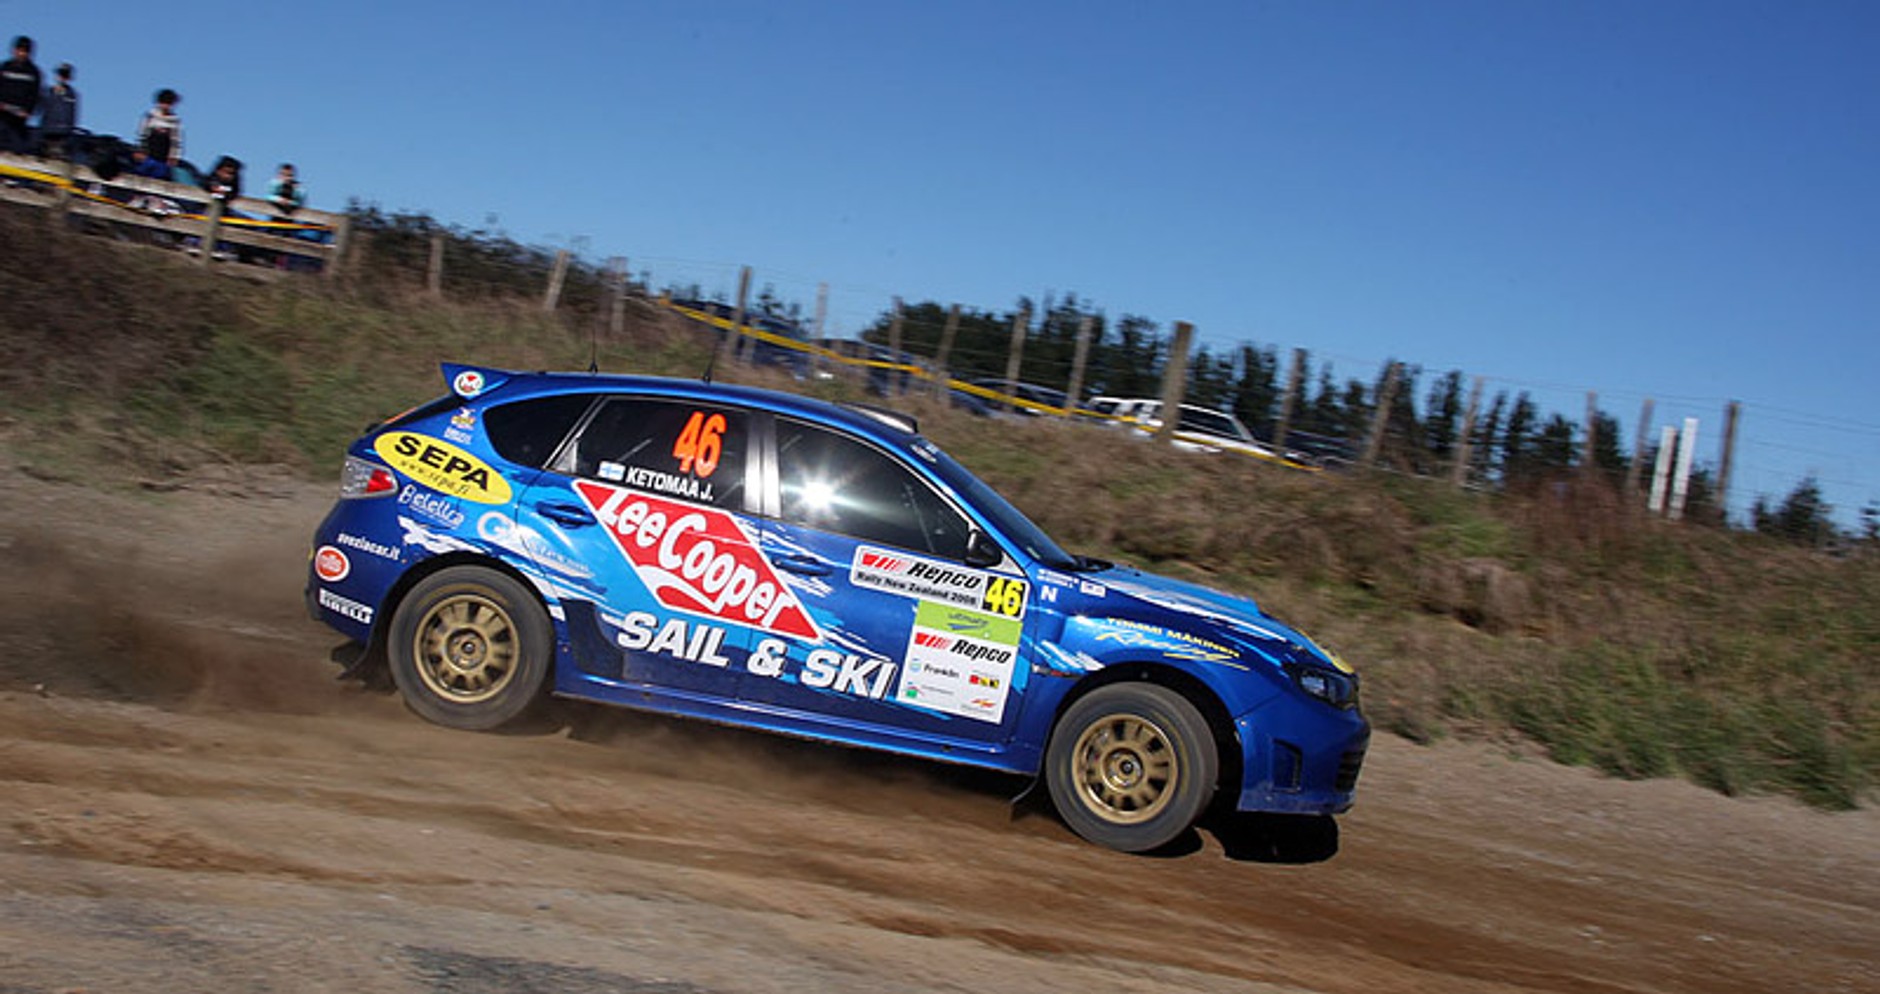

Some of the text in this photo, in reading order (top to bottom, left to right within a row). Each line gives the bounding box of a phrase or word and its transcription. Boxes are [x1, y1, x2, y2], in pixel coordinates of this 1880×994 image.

[395, 435, 489, 491] SEPA
[673, 411, 727, 478] 46
[700, 483, 714, 502] J.
[885, 576, 905, 589] New
[985, 577, 1023, 617] 46
[1041, 585, 1058, 602] N
[617, 611, 899, 700] SAIL & SKI
